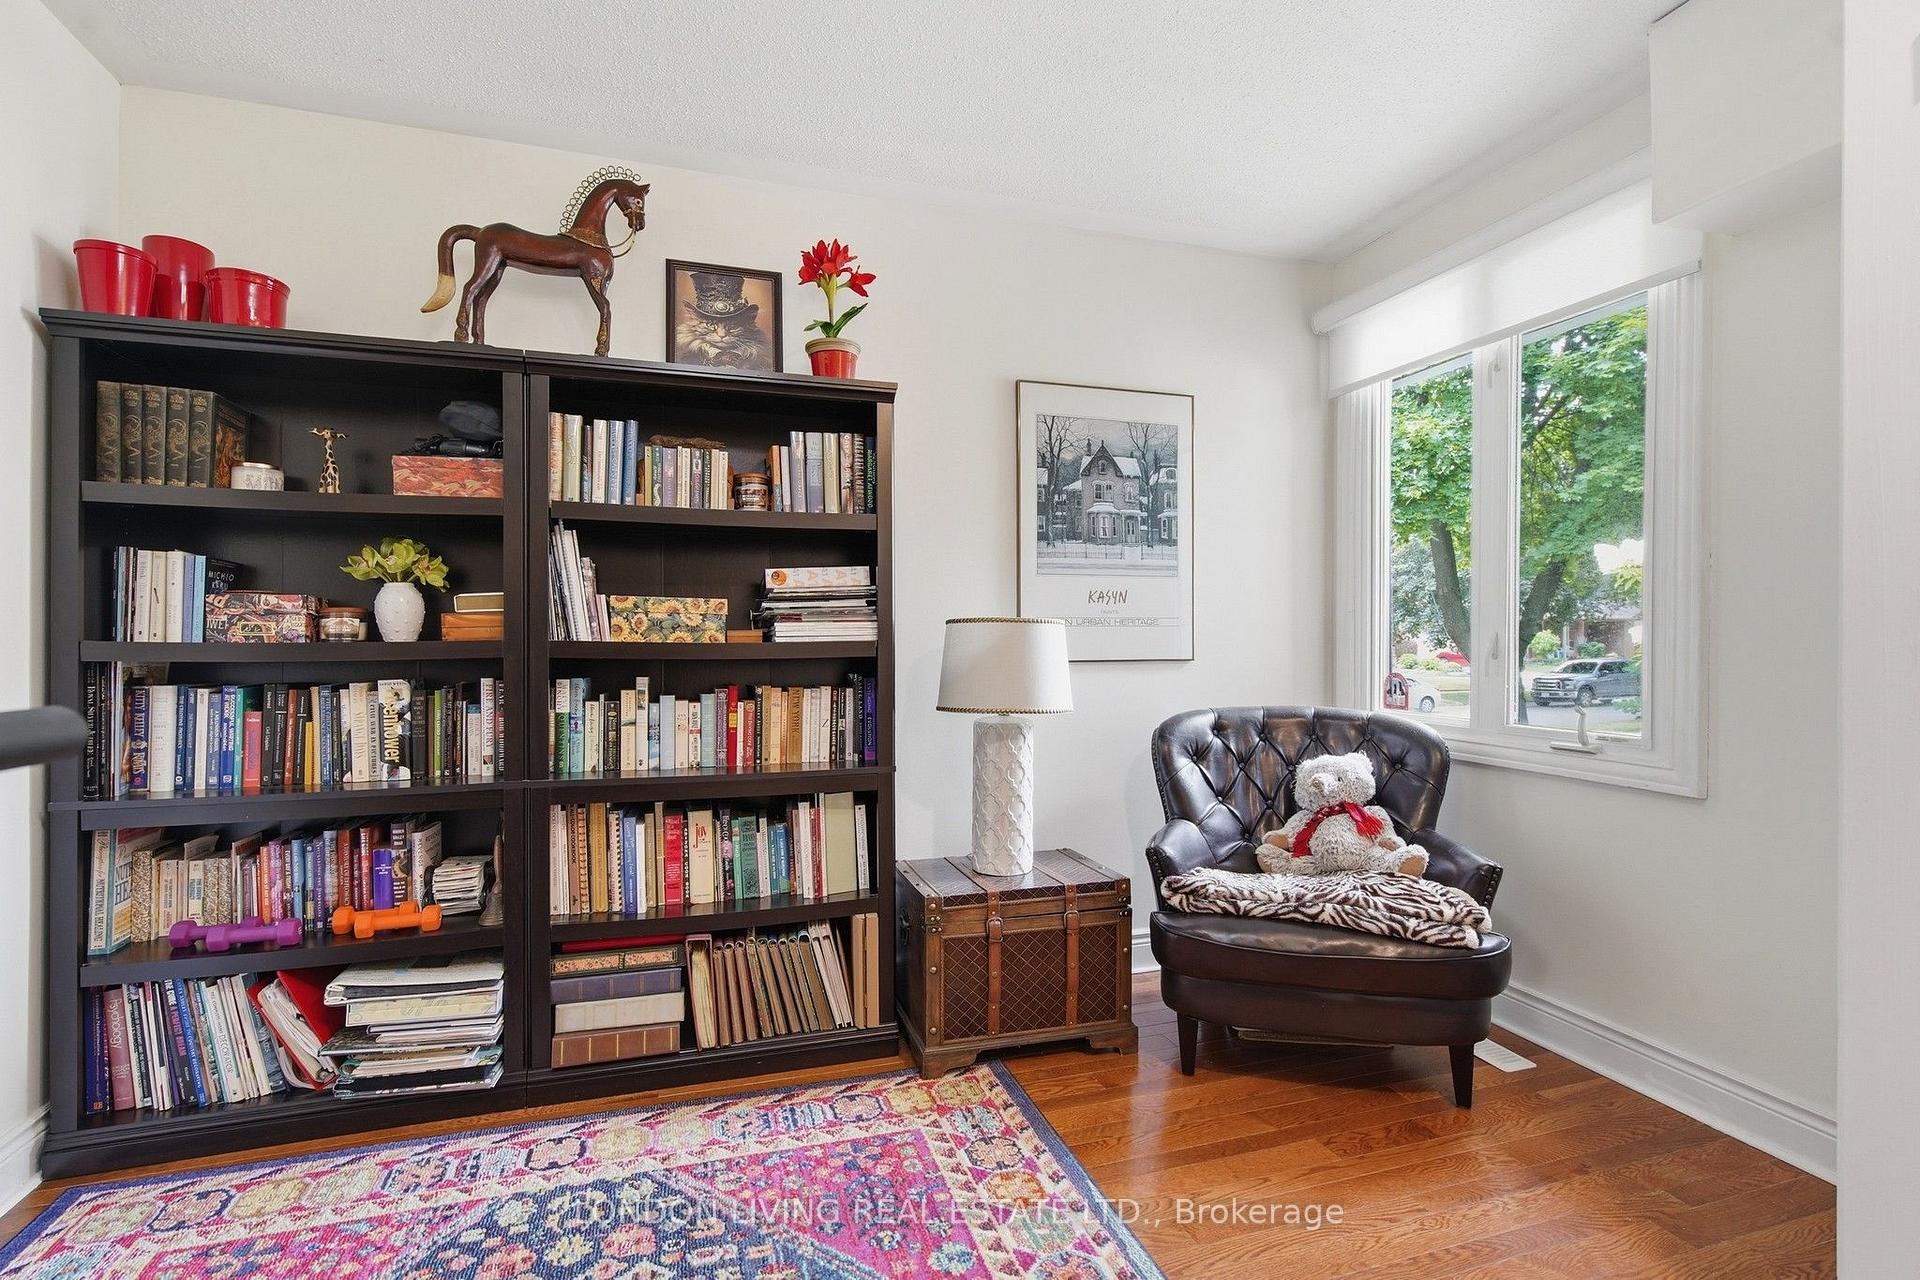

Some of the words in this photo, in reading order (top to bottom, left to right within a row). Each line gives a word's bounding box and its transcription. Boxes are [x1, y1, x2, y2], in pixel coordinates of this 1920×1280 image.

[208, 570, 235, 582] MICHIO
[1088, 589, 1128, 605] KASYN
[1076, 617, 1111, 626] URBAN
[1114, 617, 1160, 626] HERITAGE
[134, 690, 146, 711] KITTY
[791, 689, 800, 708] NEW
[133, 713, 146, 738] KELLEY
[791, 710, 801, 734] YORK
[486, 726, 494, 749] FURY
[557, 714, 567, 760] QUENTINS
[96, 879, 105, 916] NUTRITIONAL
[95, 917, 105, 942] HEALING
[165, 979, 173, 990] THE
[166, 991, 175, 1006] CURE
[110, 998, 125, 1048] Psychology
[171, 1011, 182, 1035] PERFECT
[220, 1034, 233, 1073] DECORATOR
[192, 1058, 201, 1088] DECORATING
